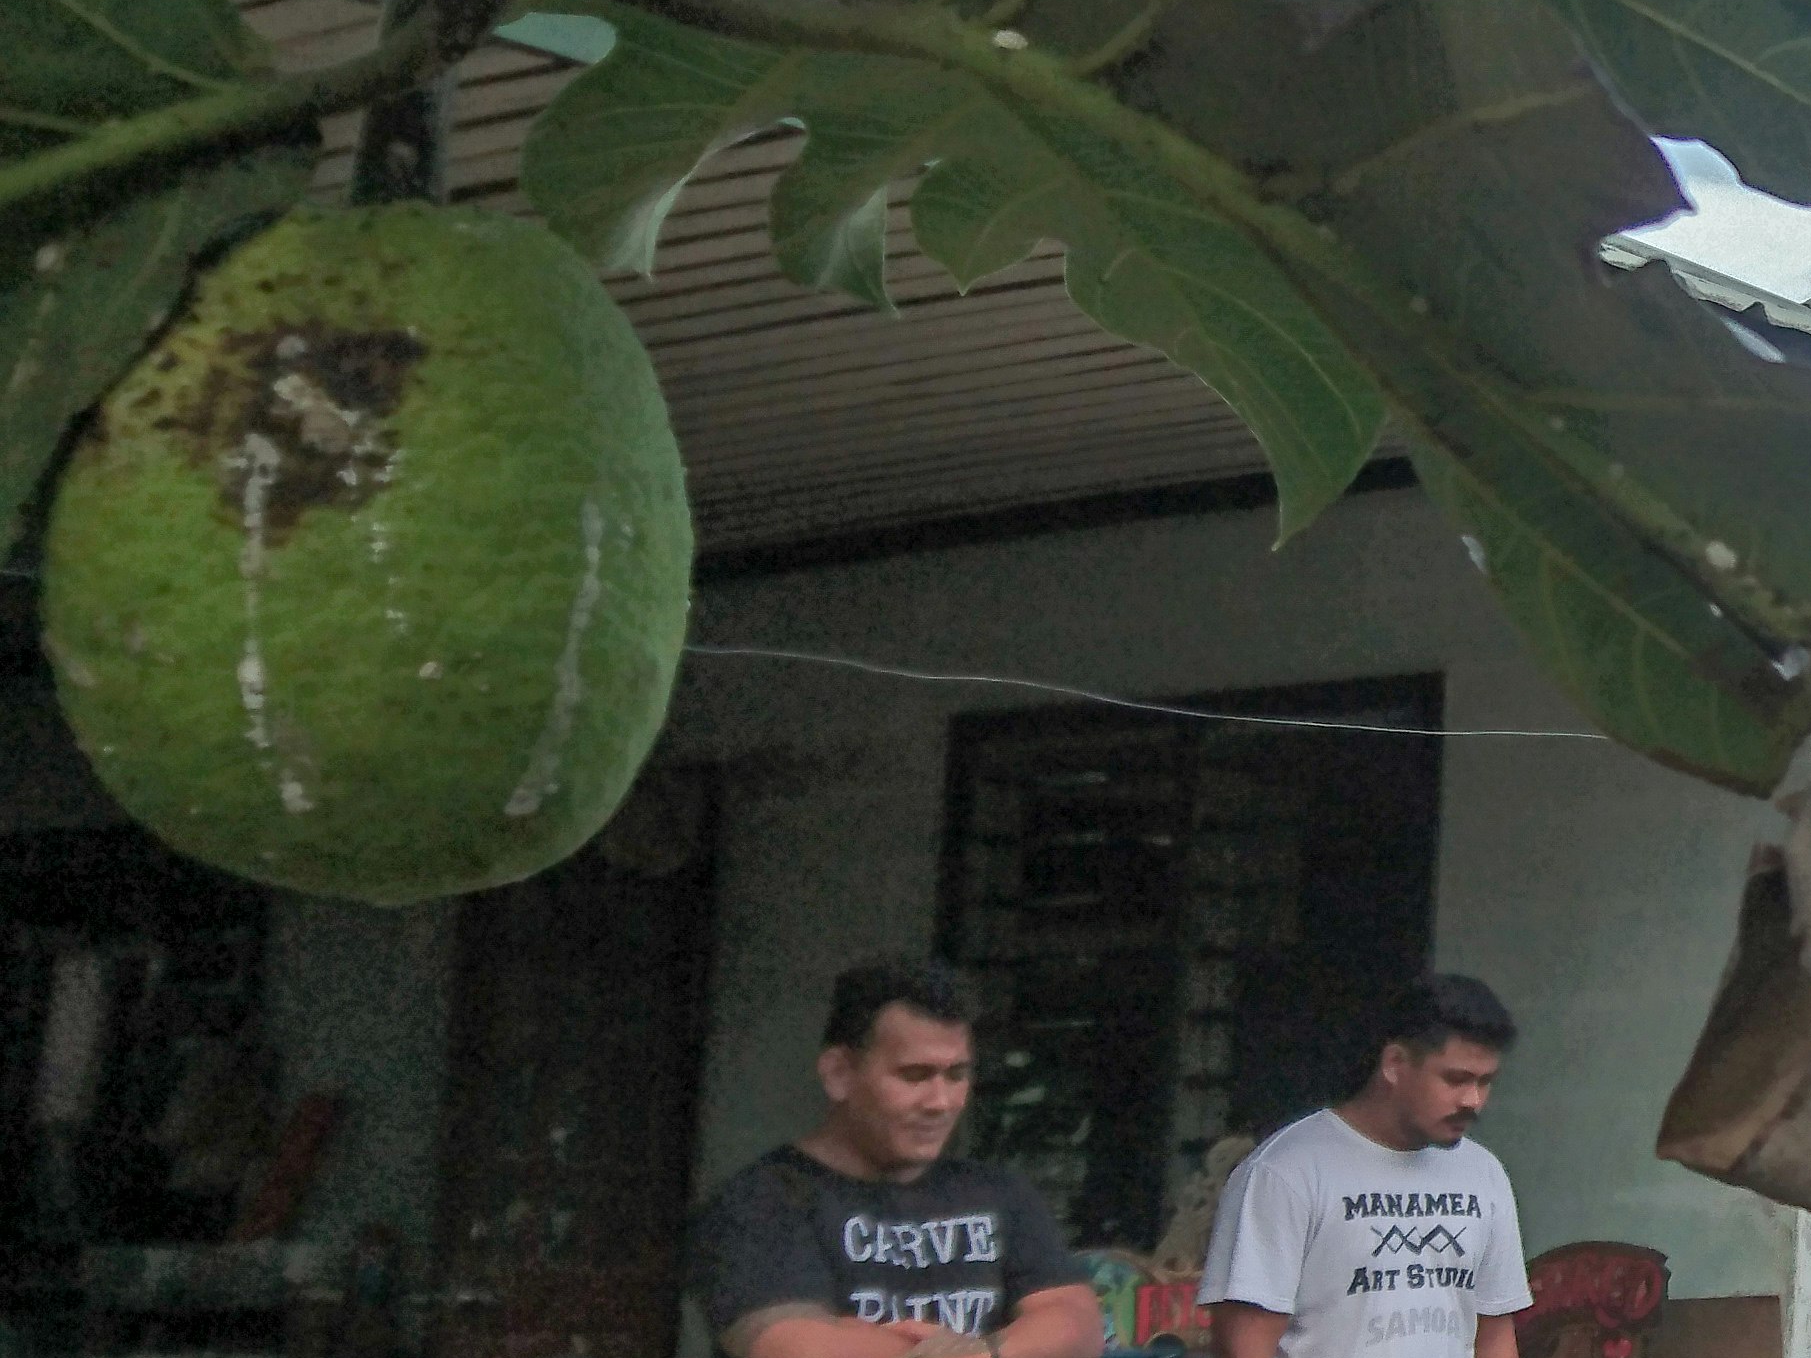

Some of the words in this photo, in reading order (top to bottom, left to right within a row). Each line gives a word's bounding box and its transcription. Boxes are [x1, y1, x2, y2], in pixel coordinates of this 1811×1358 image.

[1342, 1193, 1482, 1221] MANAMEA
[1347, 1267, 1400, 1296] ART
[1366, 1307, 1461, 1346] SAMOA
